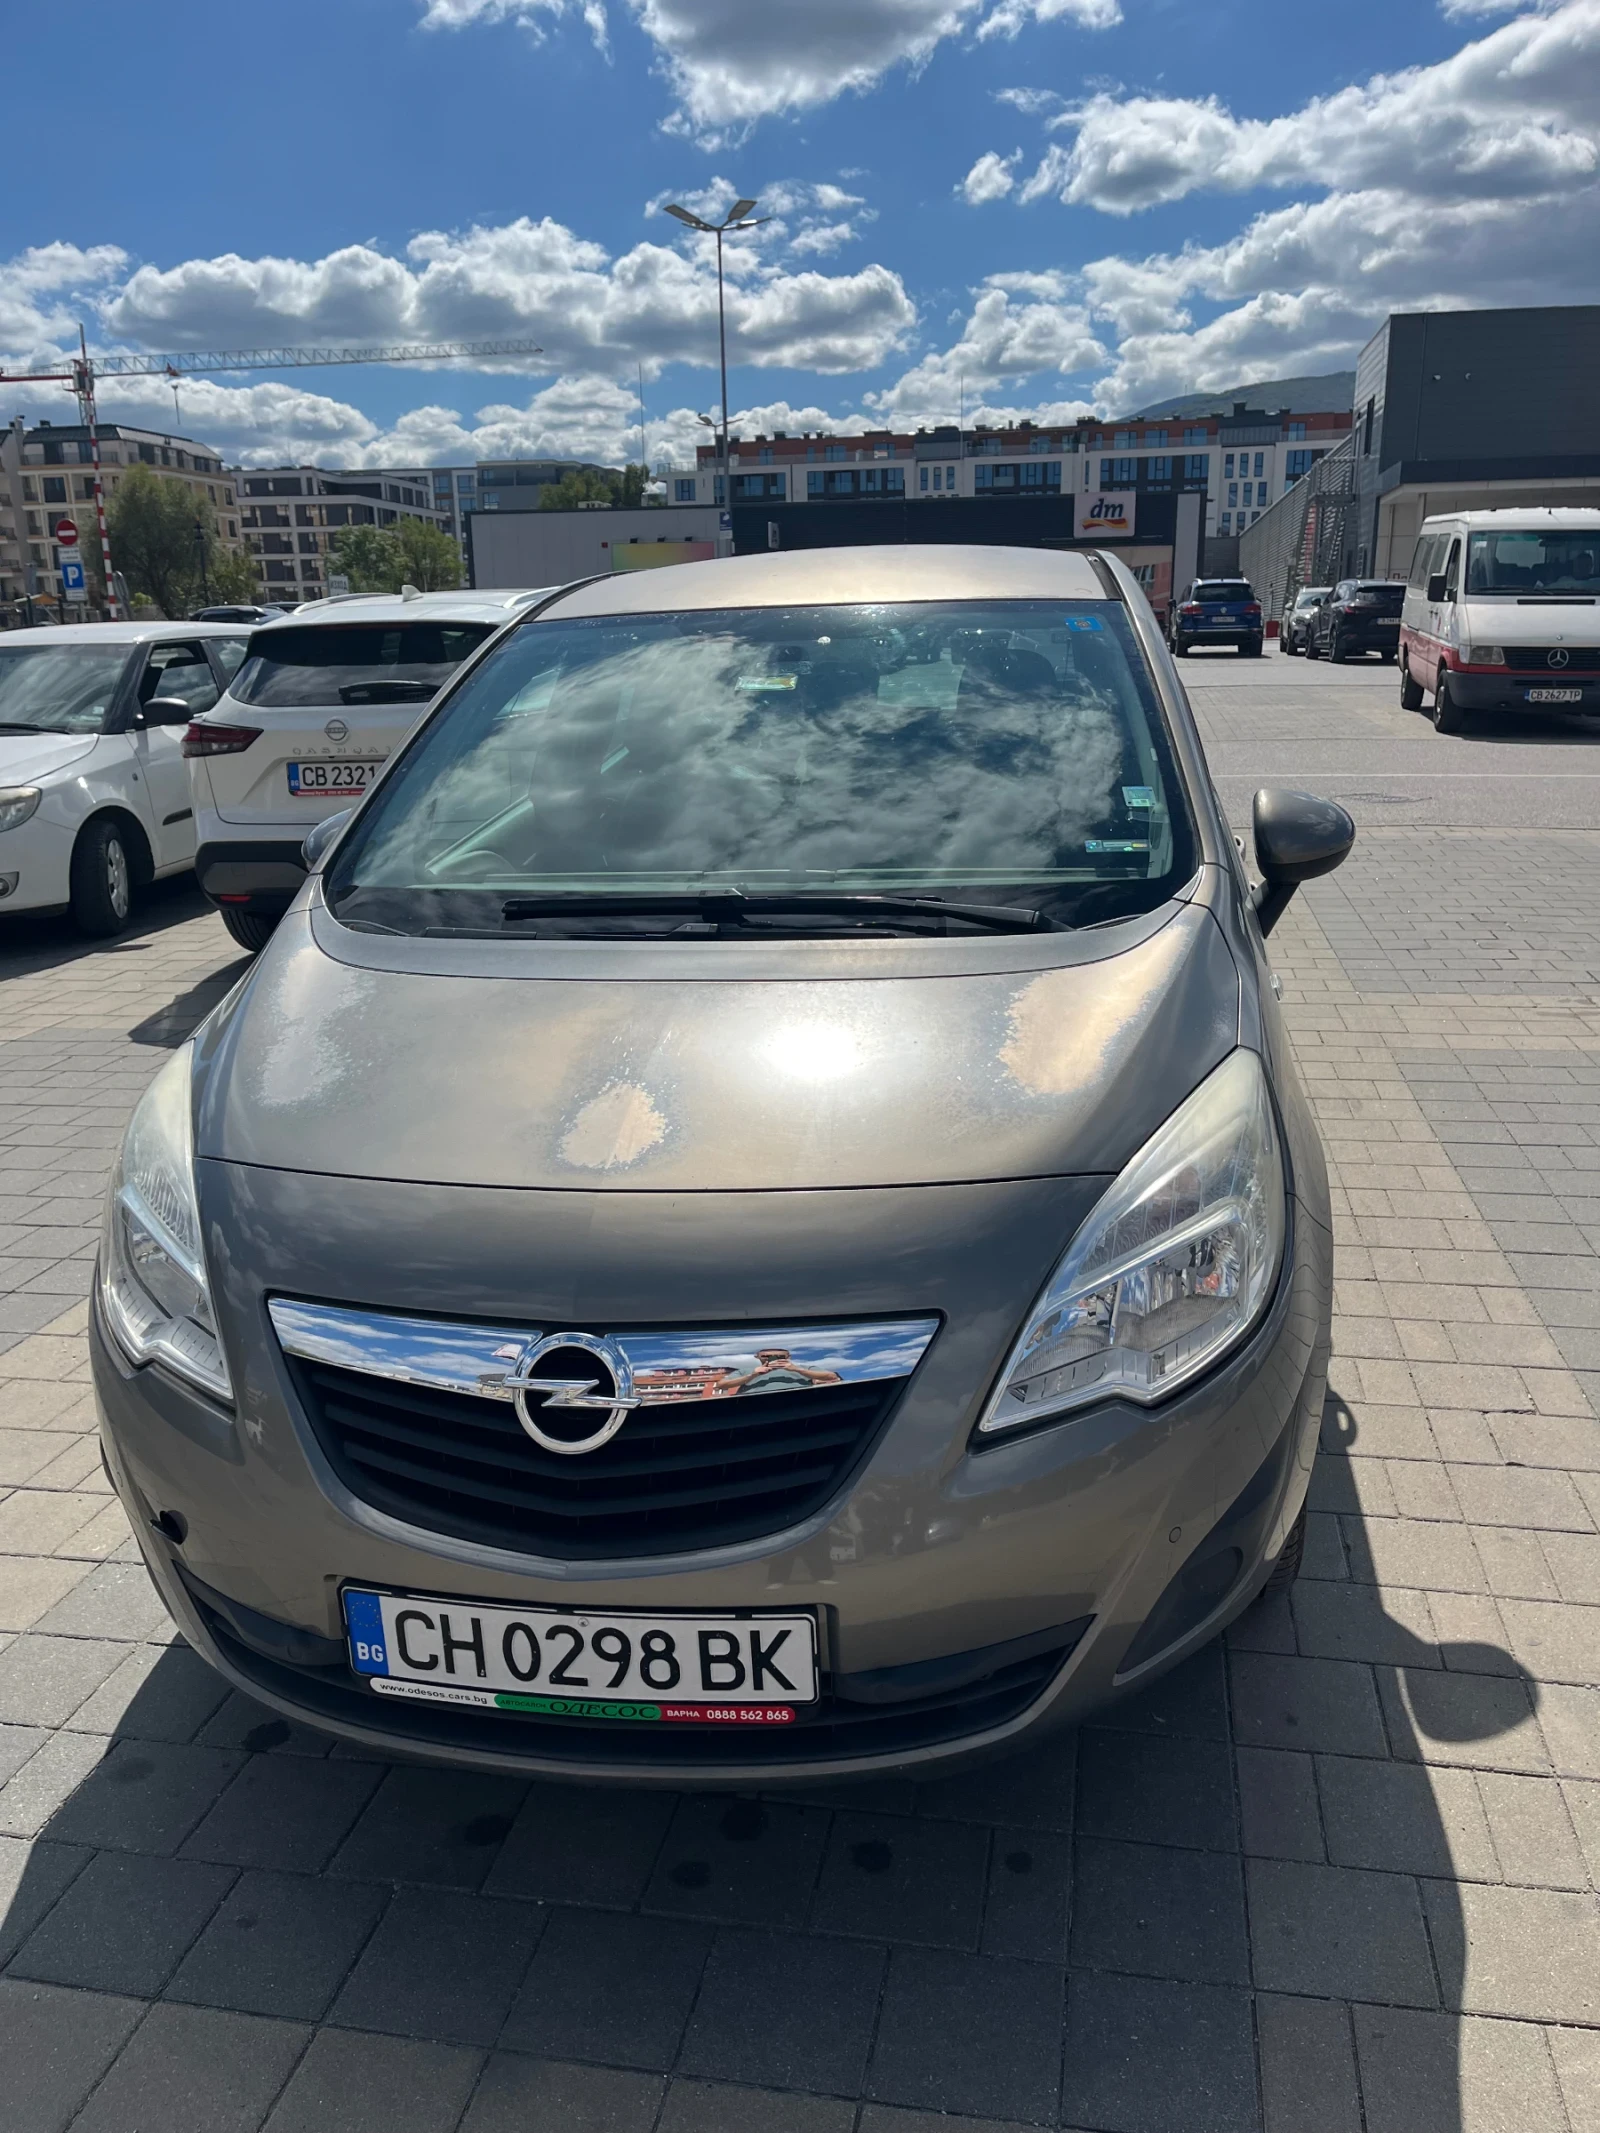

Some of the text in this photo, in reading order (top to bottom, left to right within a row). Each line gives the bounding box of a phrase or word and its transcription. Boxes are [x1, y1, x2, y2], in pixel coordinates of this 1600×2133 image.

[1090, 498, 1123, 518] dm
[67, 566, 79, 586] P
[1531, 691, 1543, 700] CB
[1545, 691, 1567, 700] 2627
[1569, 691, 1580, 700] TP
[302, 765, 375, 786] CB 2321
[356, 1641, 384, 1663] BG
[395, 1609, 798, 1691] CH 0298 BK
[500, 1699, 656, 1719] АВТОСАЛОН ОДЕСОС
[667, 1709, 789, 1721] ВАРНА 0888 562 865
